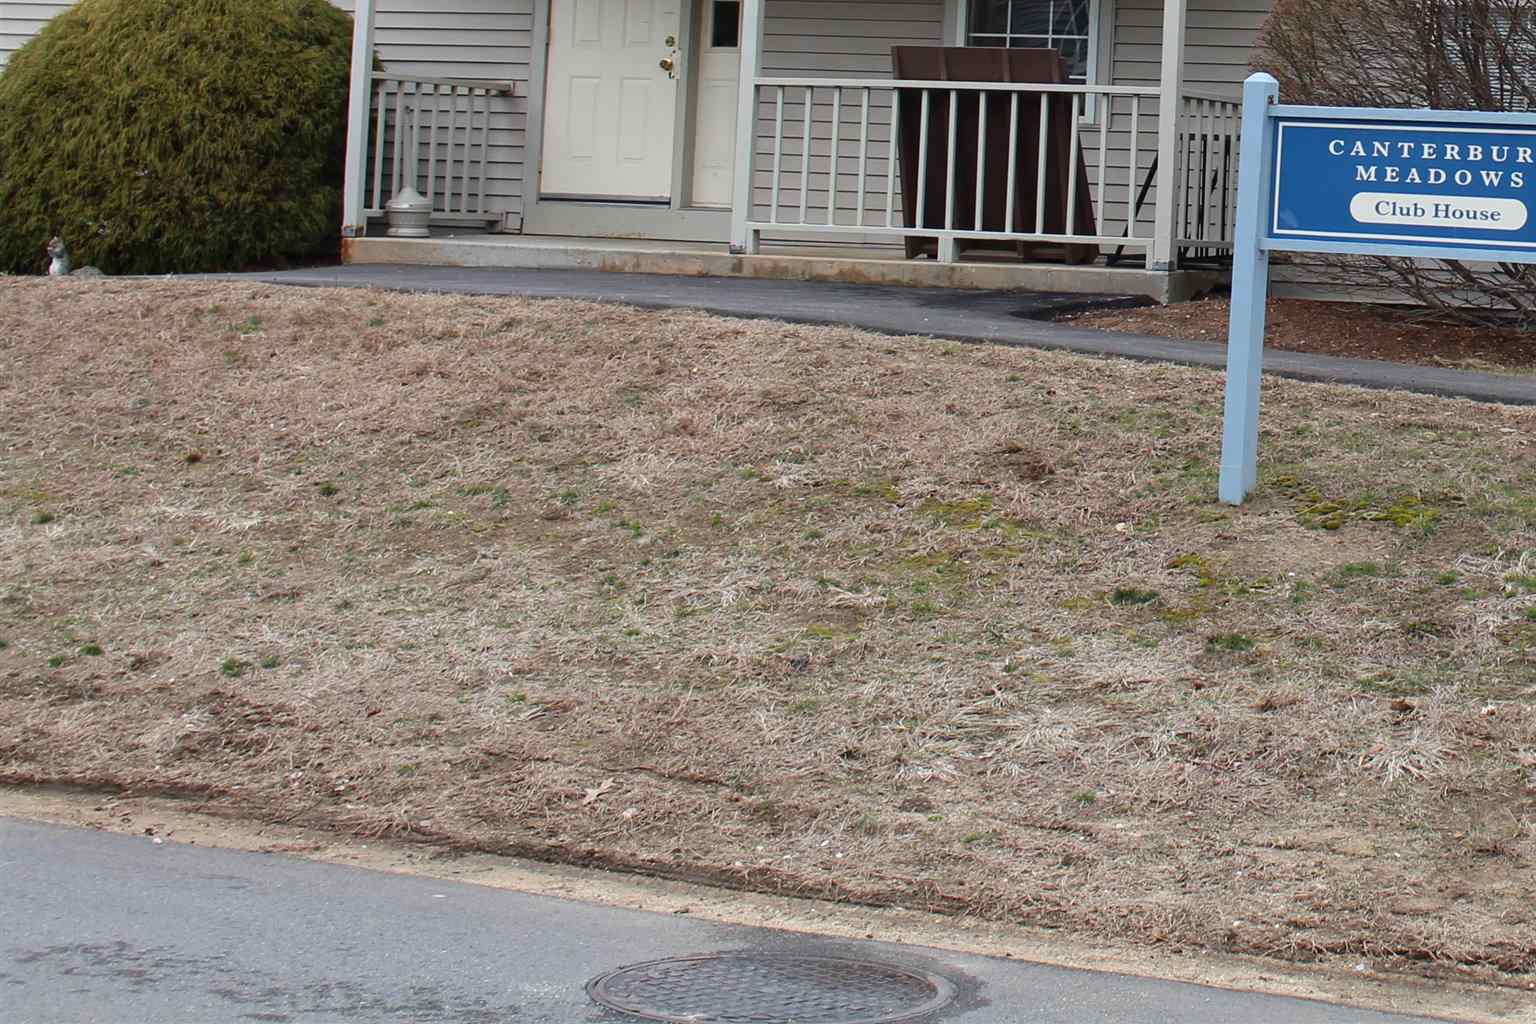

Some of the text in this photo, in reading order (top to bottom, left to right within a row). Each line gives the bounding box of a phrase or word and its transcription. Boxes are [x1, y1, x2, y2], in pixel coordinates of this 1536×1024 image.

[1355, 165, 1525, 188] MEADOWS
[1374, 200, 1502, 222] Club House
